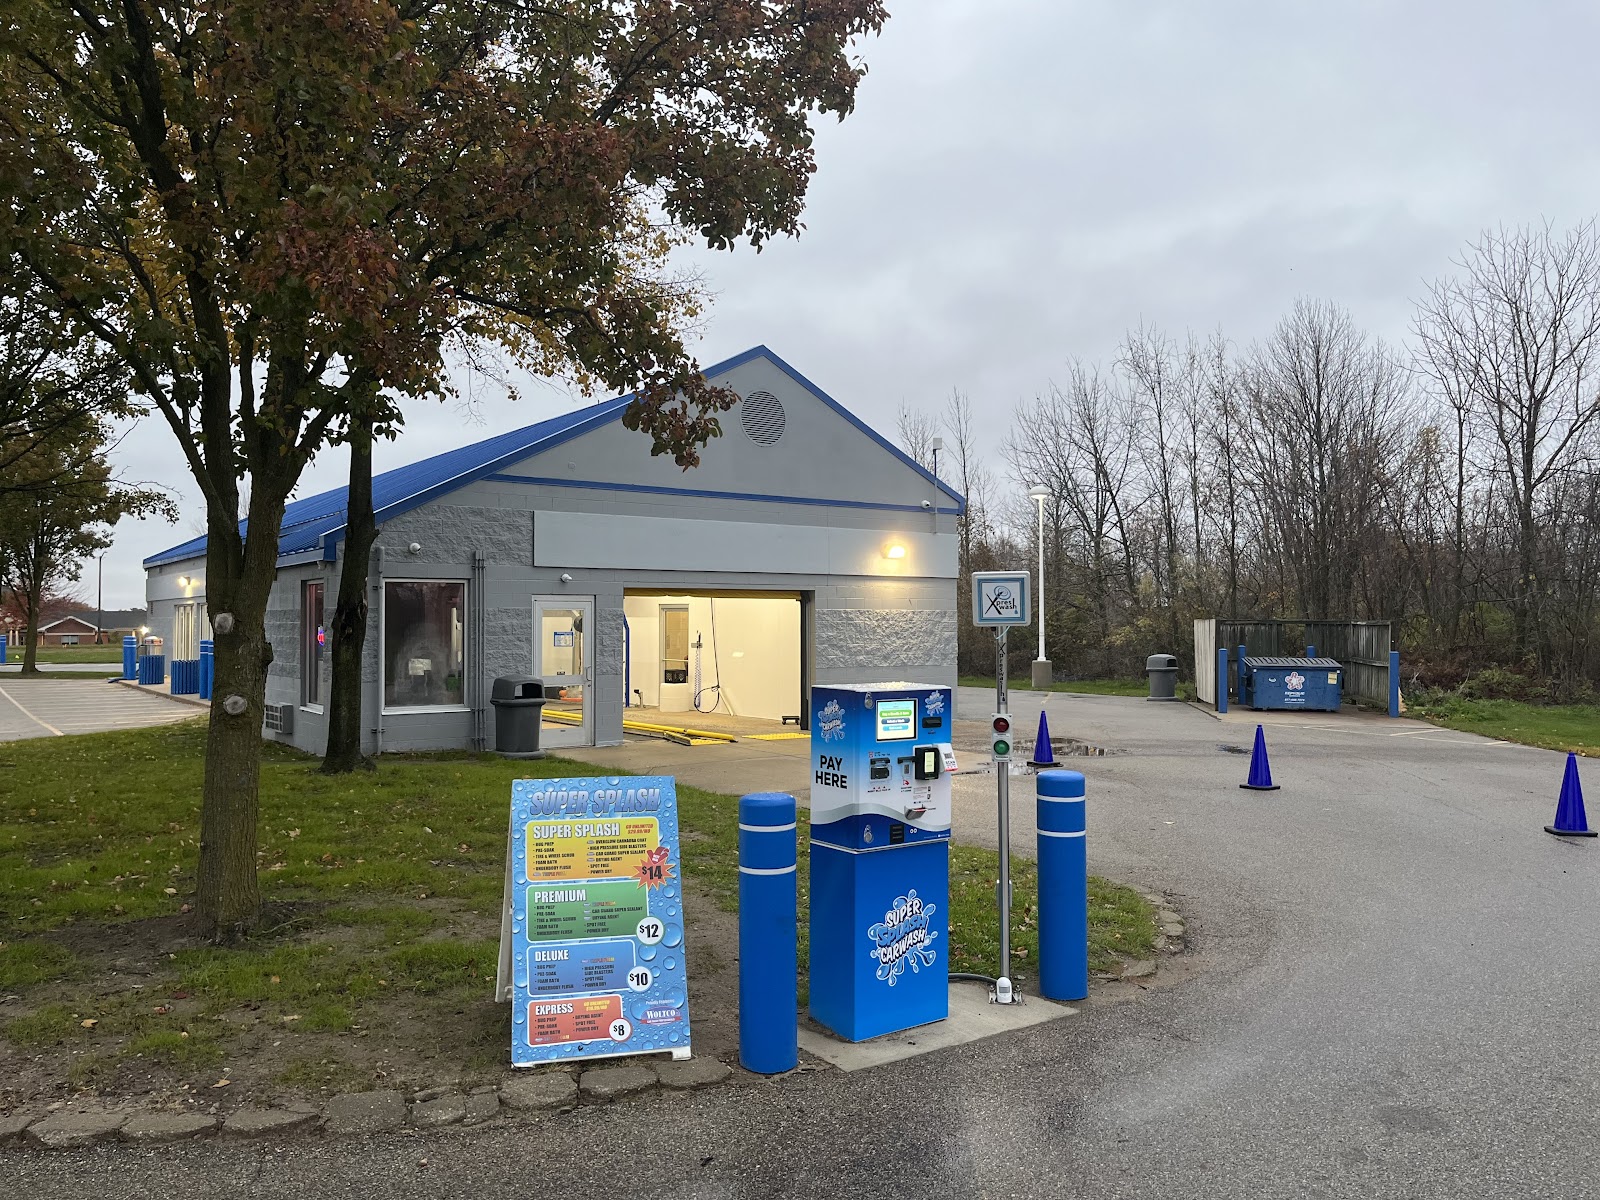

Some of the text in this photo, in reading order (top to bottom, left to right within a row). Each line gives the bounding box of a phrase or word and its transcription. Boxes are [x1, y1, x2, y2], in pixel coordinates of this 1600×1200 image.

[999, 598, 1017, 609] wash
[820, 755, 842, 771] PAY
[816, 770, 847, 789] HERE
[530, 789, 660, 816] SUPER SPLASH
[533, 823, 620, 839] SUPER SPLASH
[642, 866, 662, 880] $14
[535, 889, 587, 903] PREMIUM
[886, 899, 922, 927] SUPER
[640, 924, 659, 938] $12
[877, 916, 928, 947] SPLASH
[880, 929, 926, 964] CARWASH
[535, 950, 569, 962] DELUXE
[630, 973, 648, 986] $10
[536, 1003, 573, 1015] EXPRESS
[646, 1010, 675, 1018] WOLTCO
[613, 1024, 624, 1036] $8
